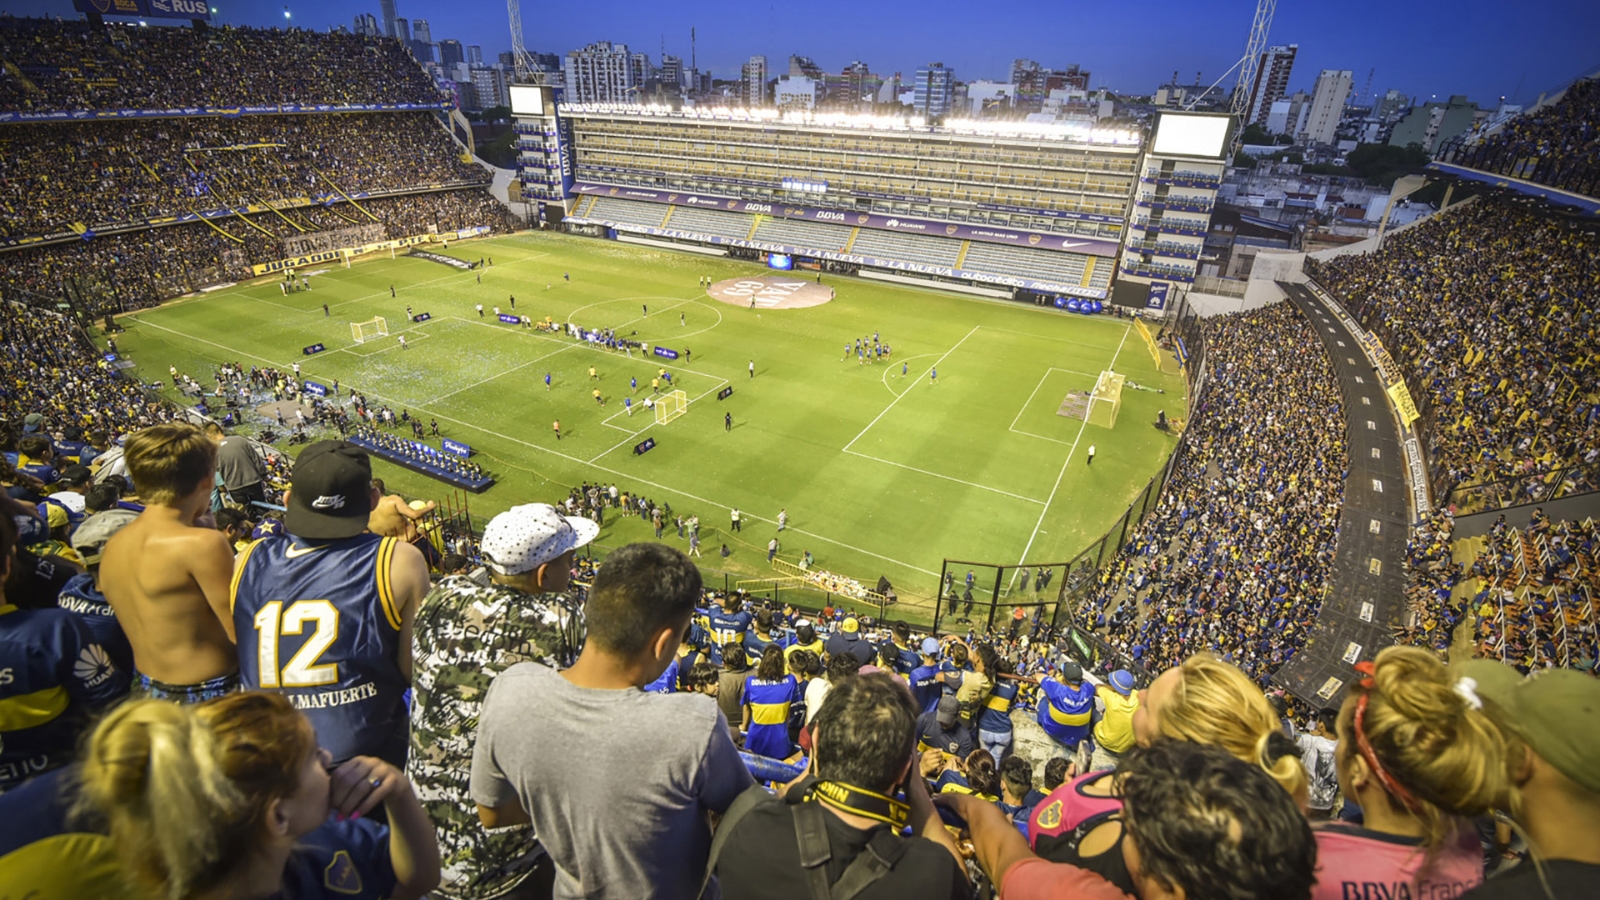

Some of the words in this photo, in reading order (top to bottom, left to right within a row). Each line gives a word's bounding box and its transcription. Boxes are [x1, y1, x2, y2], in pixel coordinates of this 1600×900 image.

[173, 0, 208, 14] RUS
[561, 143, 571, 176] BBVA
[744, 203, 772, 213] BBVA
[816, 210, 845, 222] BBVA
[899, 222, 926, 230] HUAWEI
[662, 230, 677, 238] LA
[677, 232, 712, 242] NUEVA
[748, 241, 784, 252] NUEVA
[806, 249, 822, 257] LA
[824, 252, 864, 264] NUEVA
[888, 260, 907, 268] LA
[908, 263, 953, 276] NUEVA
[254, 600, 340, 688] 12
[716, 628, 736, 649] 10
[1342, 881, 1413, 900] BBVA
